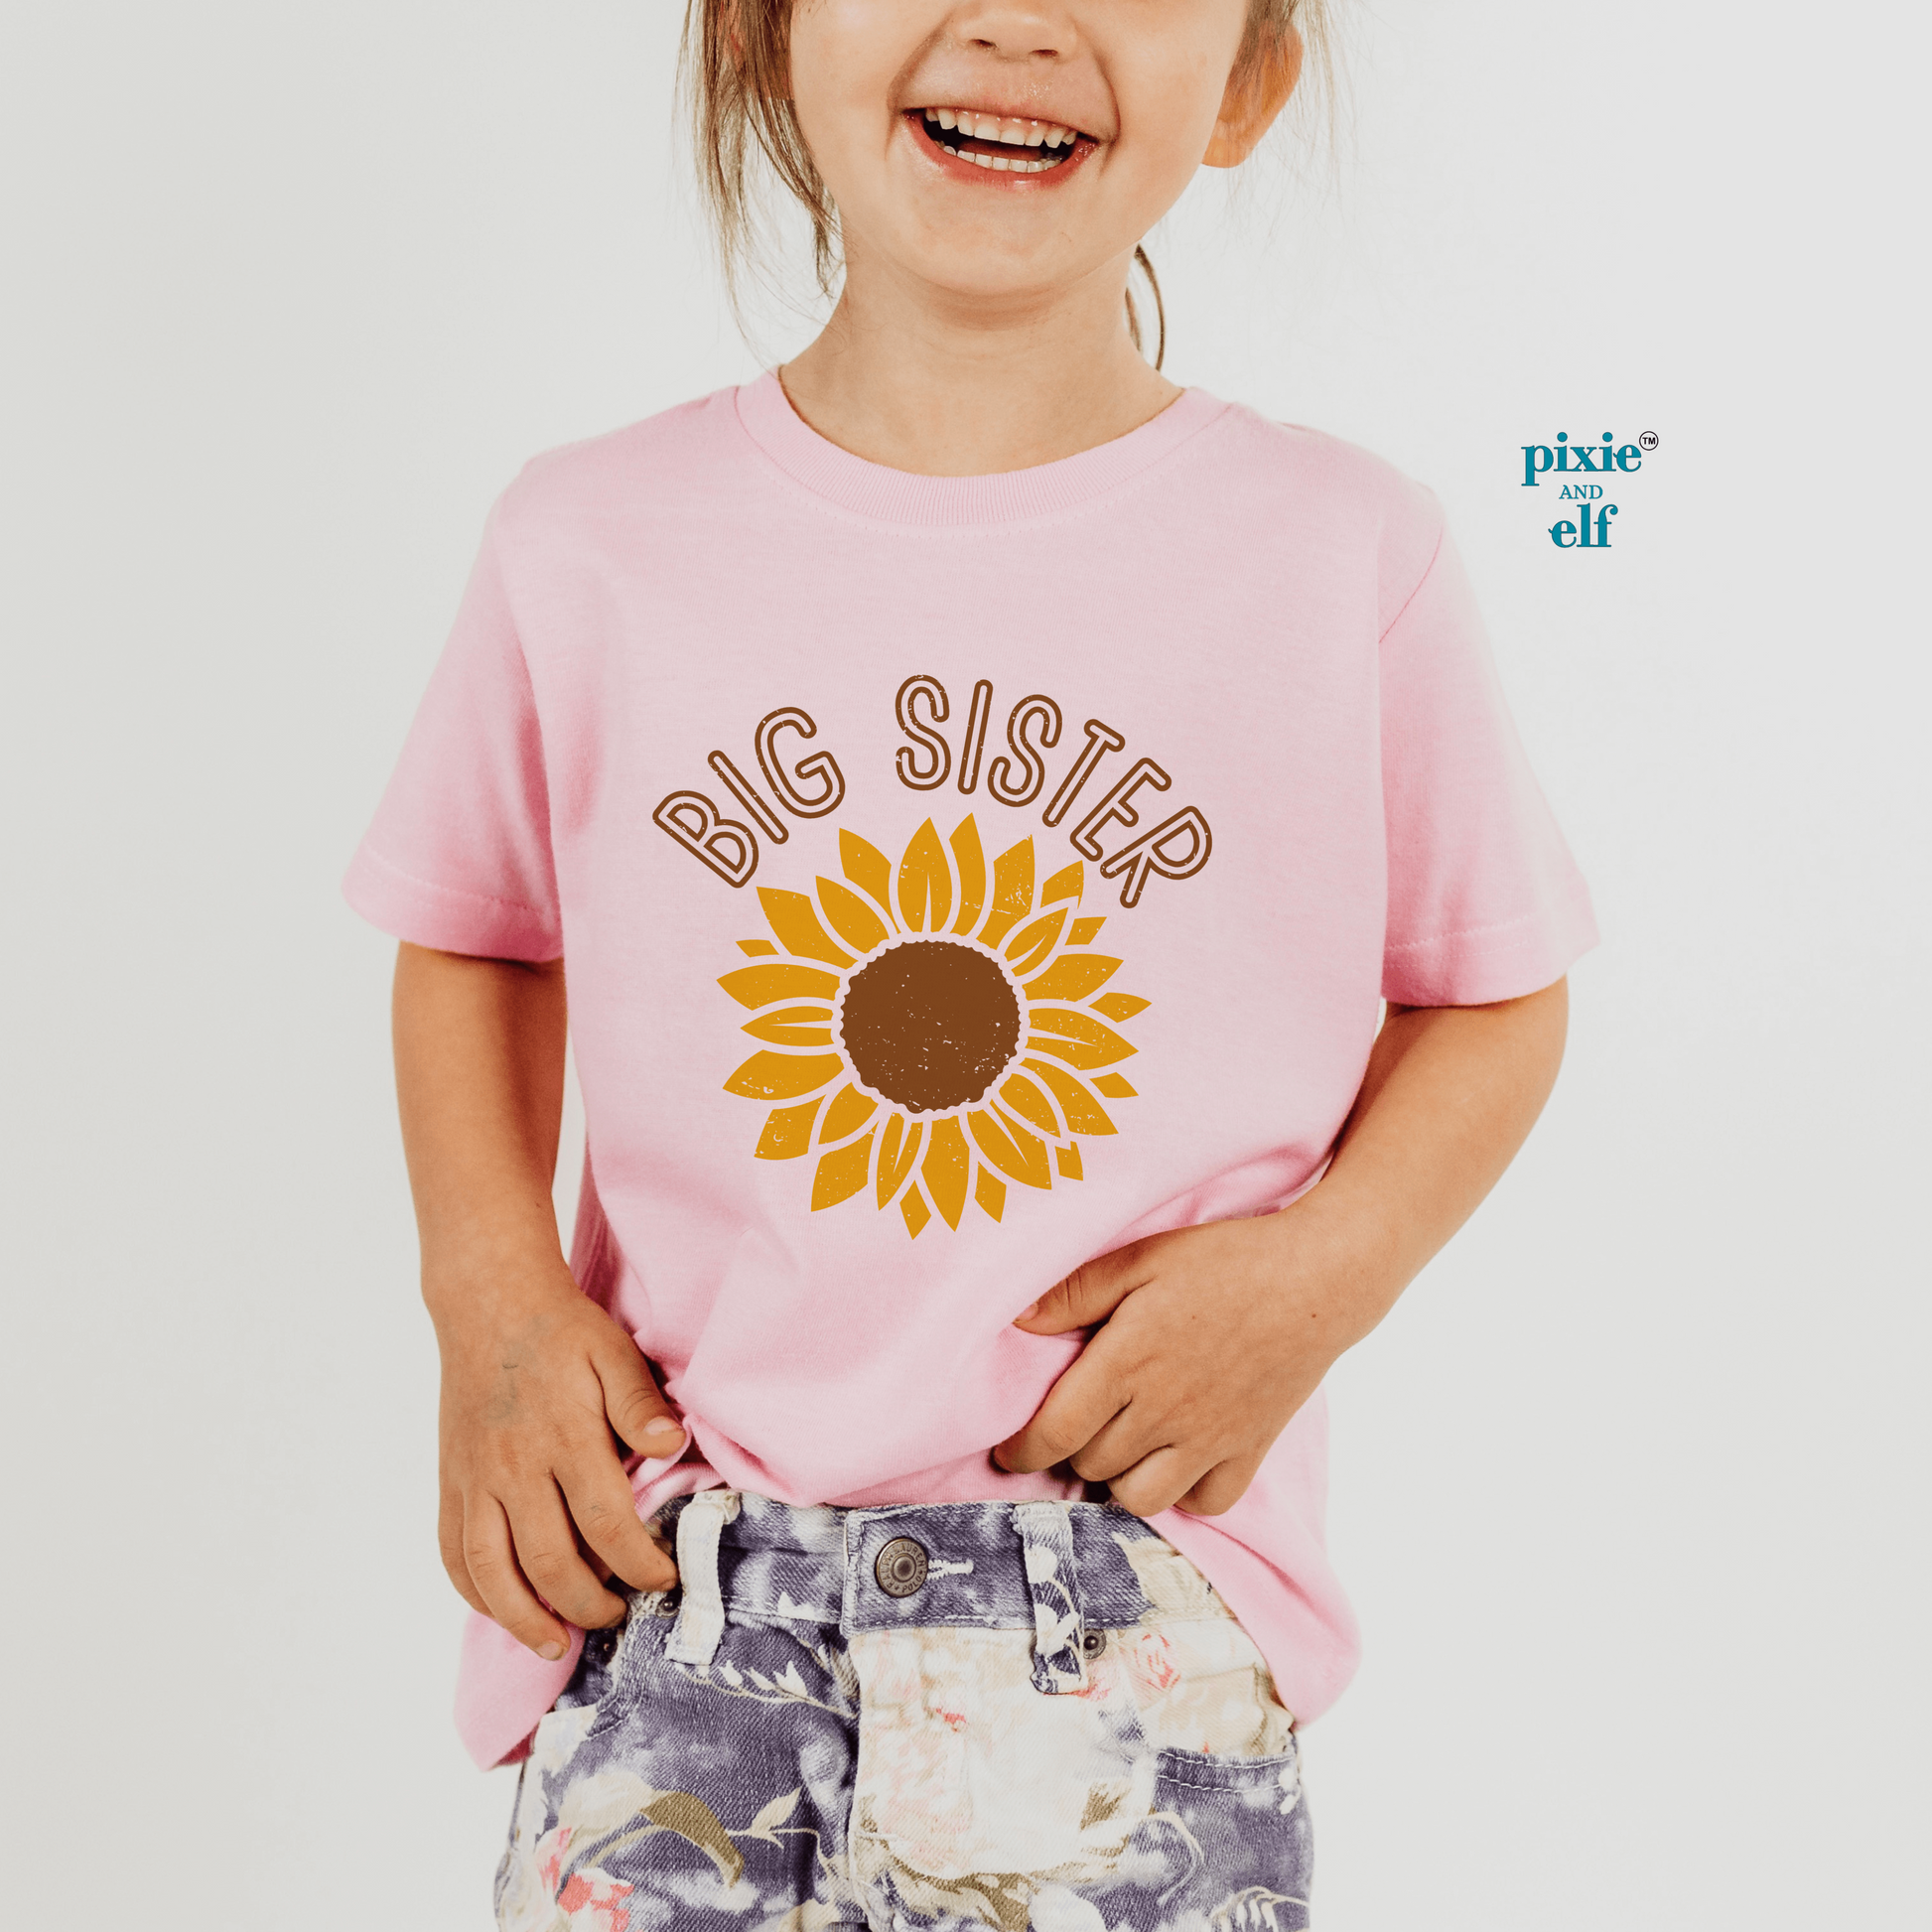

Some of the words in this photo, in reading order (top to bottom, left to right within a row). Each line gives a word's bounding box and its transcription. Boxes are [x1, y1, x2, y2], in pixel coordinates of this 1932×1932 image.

[652, 707, 846, 889] BIG
[895, 674, 1212, 908] SISTER
[901, 1576, 922, 1592] POLO
